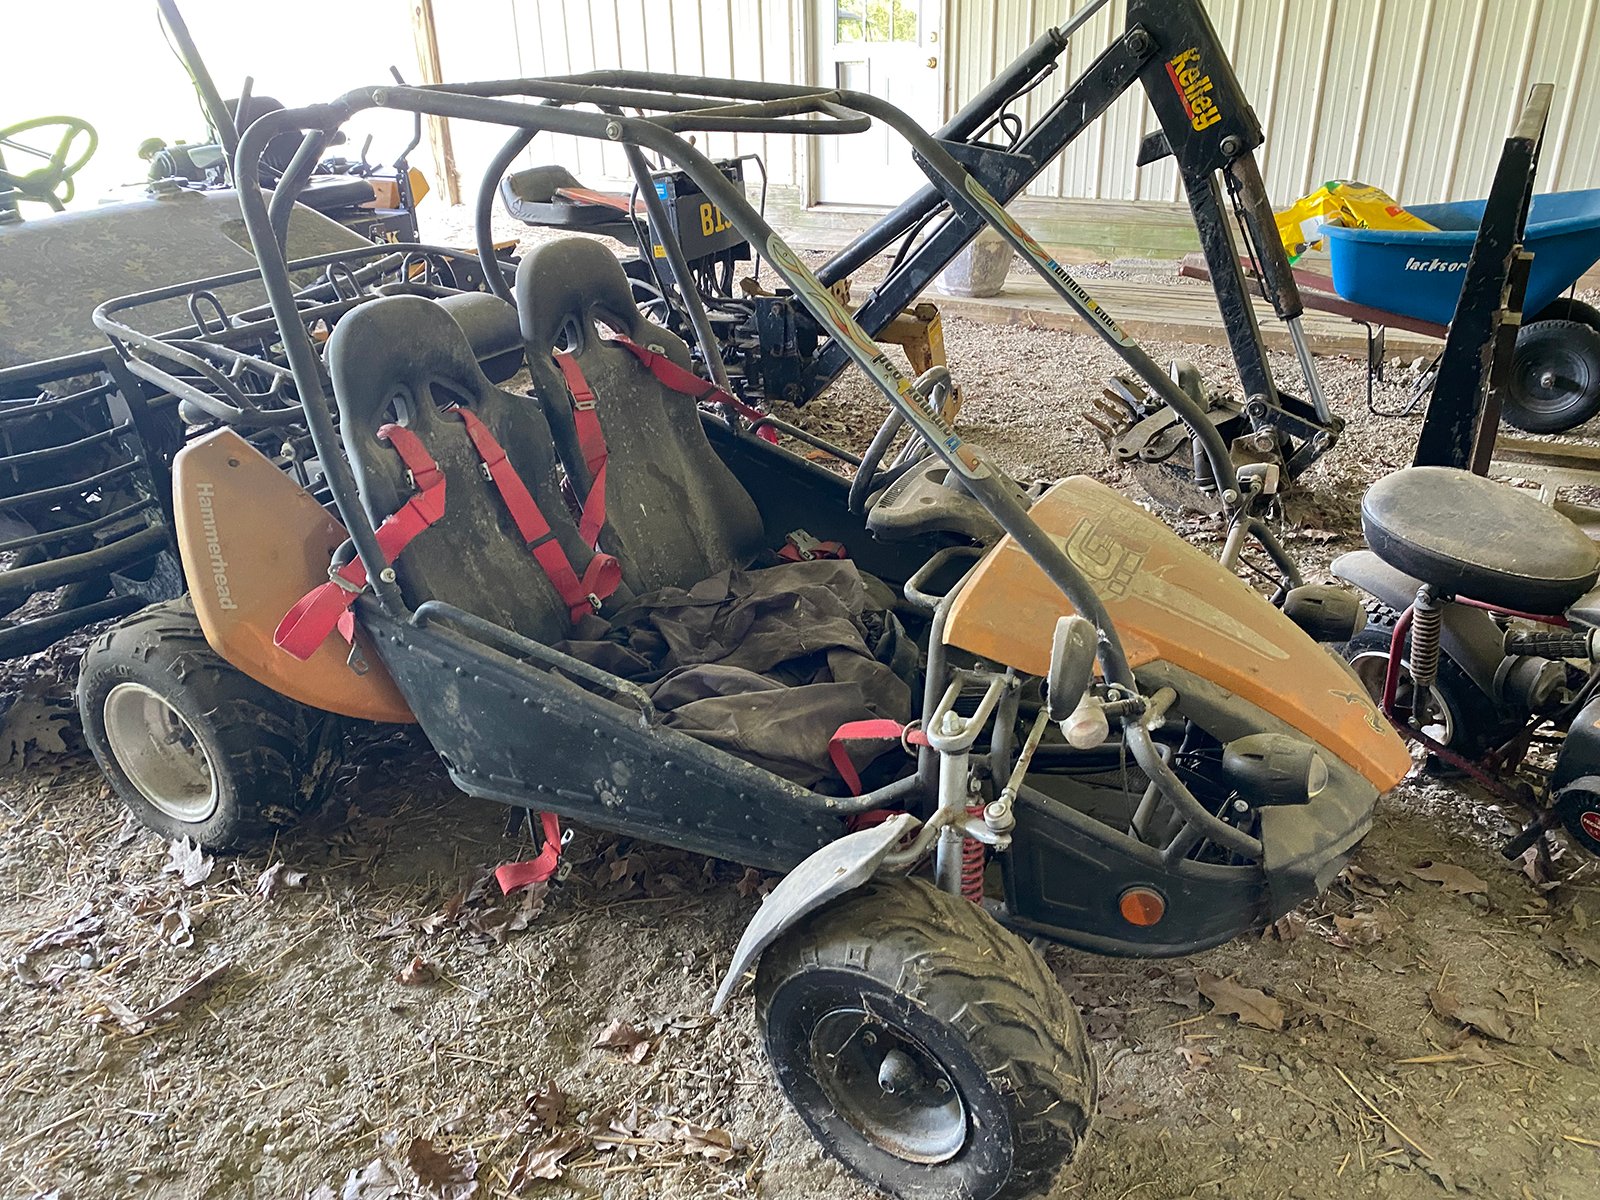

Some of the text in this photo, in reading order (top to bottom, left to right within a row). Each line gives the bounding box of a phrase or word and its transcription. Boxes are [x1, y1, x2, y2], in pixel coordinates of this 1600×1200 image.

[1170, 47, 1222, 132] Kelley
[700, 203, 733, 237] B1
[196, 482, 238, 610] Hammerhead
